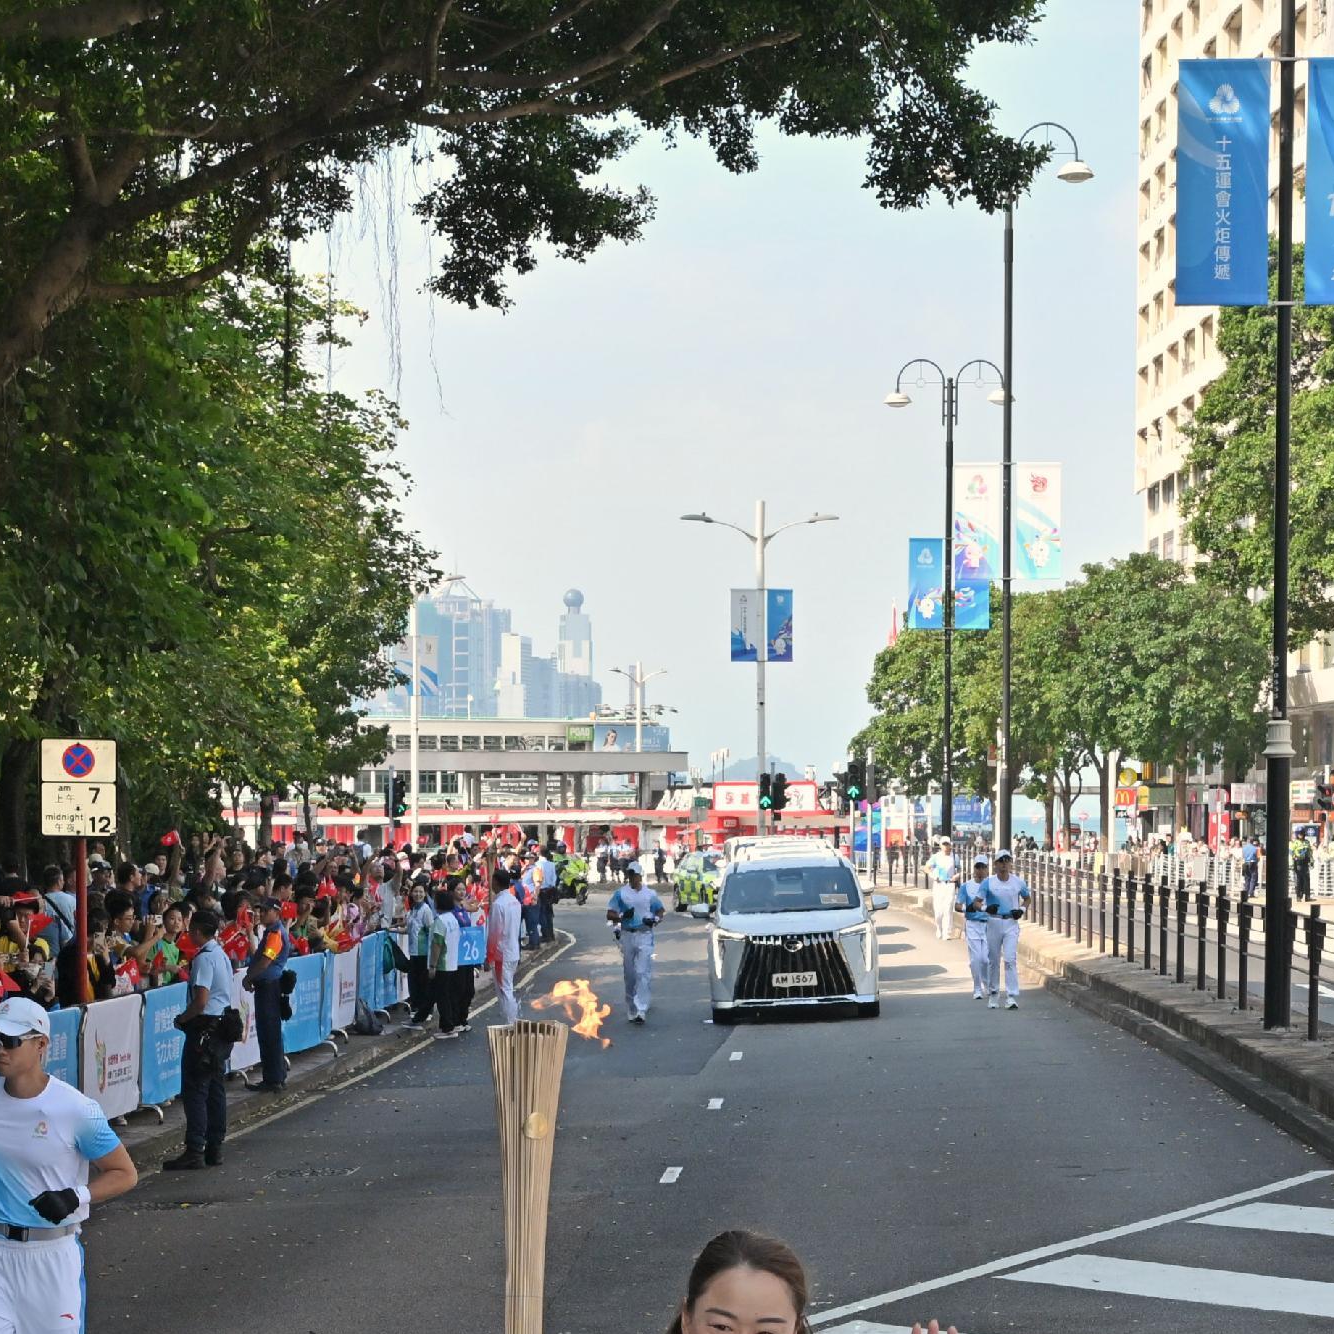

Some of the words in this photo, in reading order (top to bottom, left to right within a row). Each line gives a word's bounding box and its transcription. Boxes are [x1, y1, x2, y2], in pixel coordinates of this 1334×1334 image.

[1214, 135, 1233, 281] 十五運會火炬傳遞
[55, 794, 75, 803] 上午
[89, 787, 100, 804] 7
[45, 813, 84, 822] midnight
[89, 816, 111, 833] 12
[463, 940, 479, 961] 26
[776, 975, 788, 984] AM
